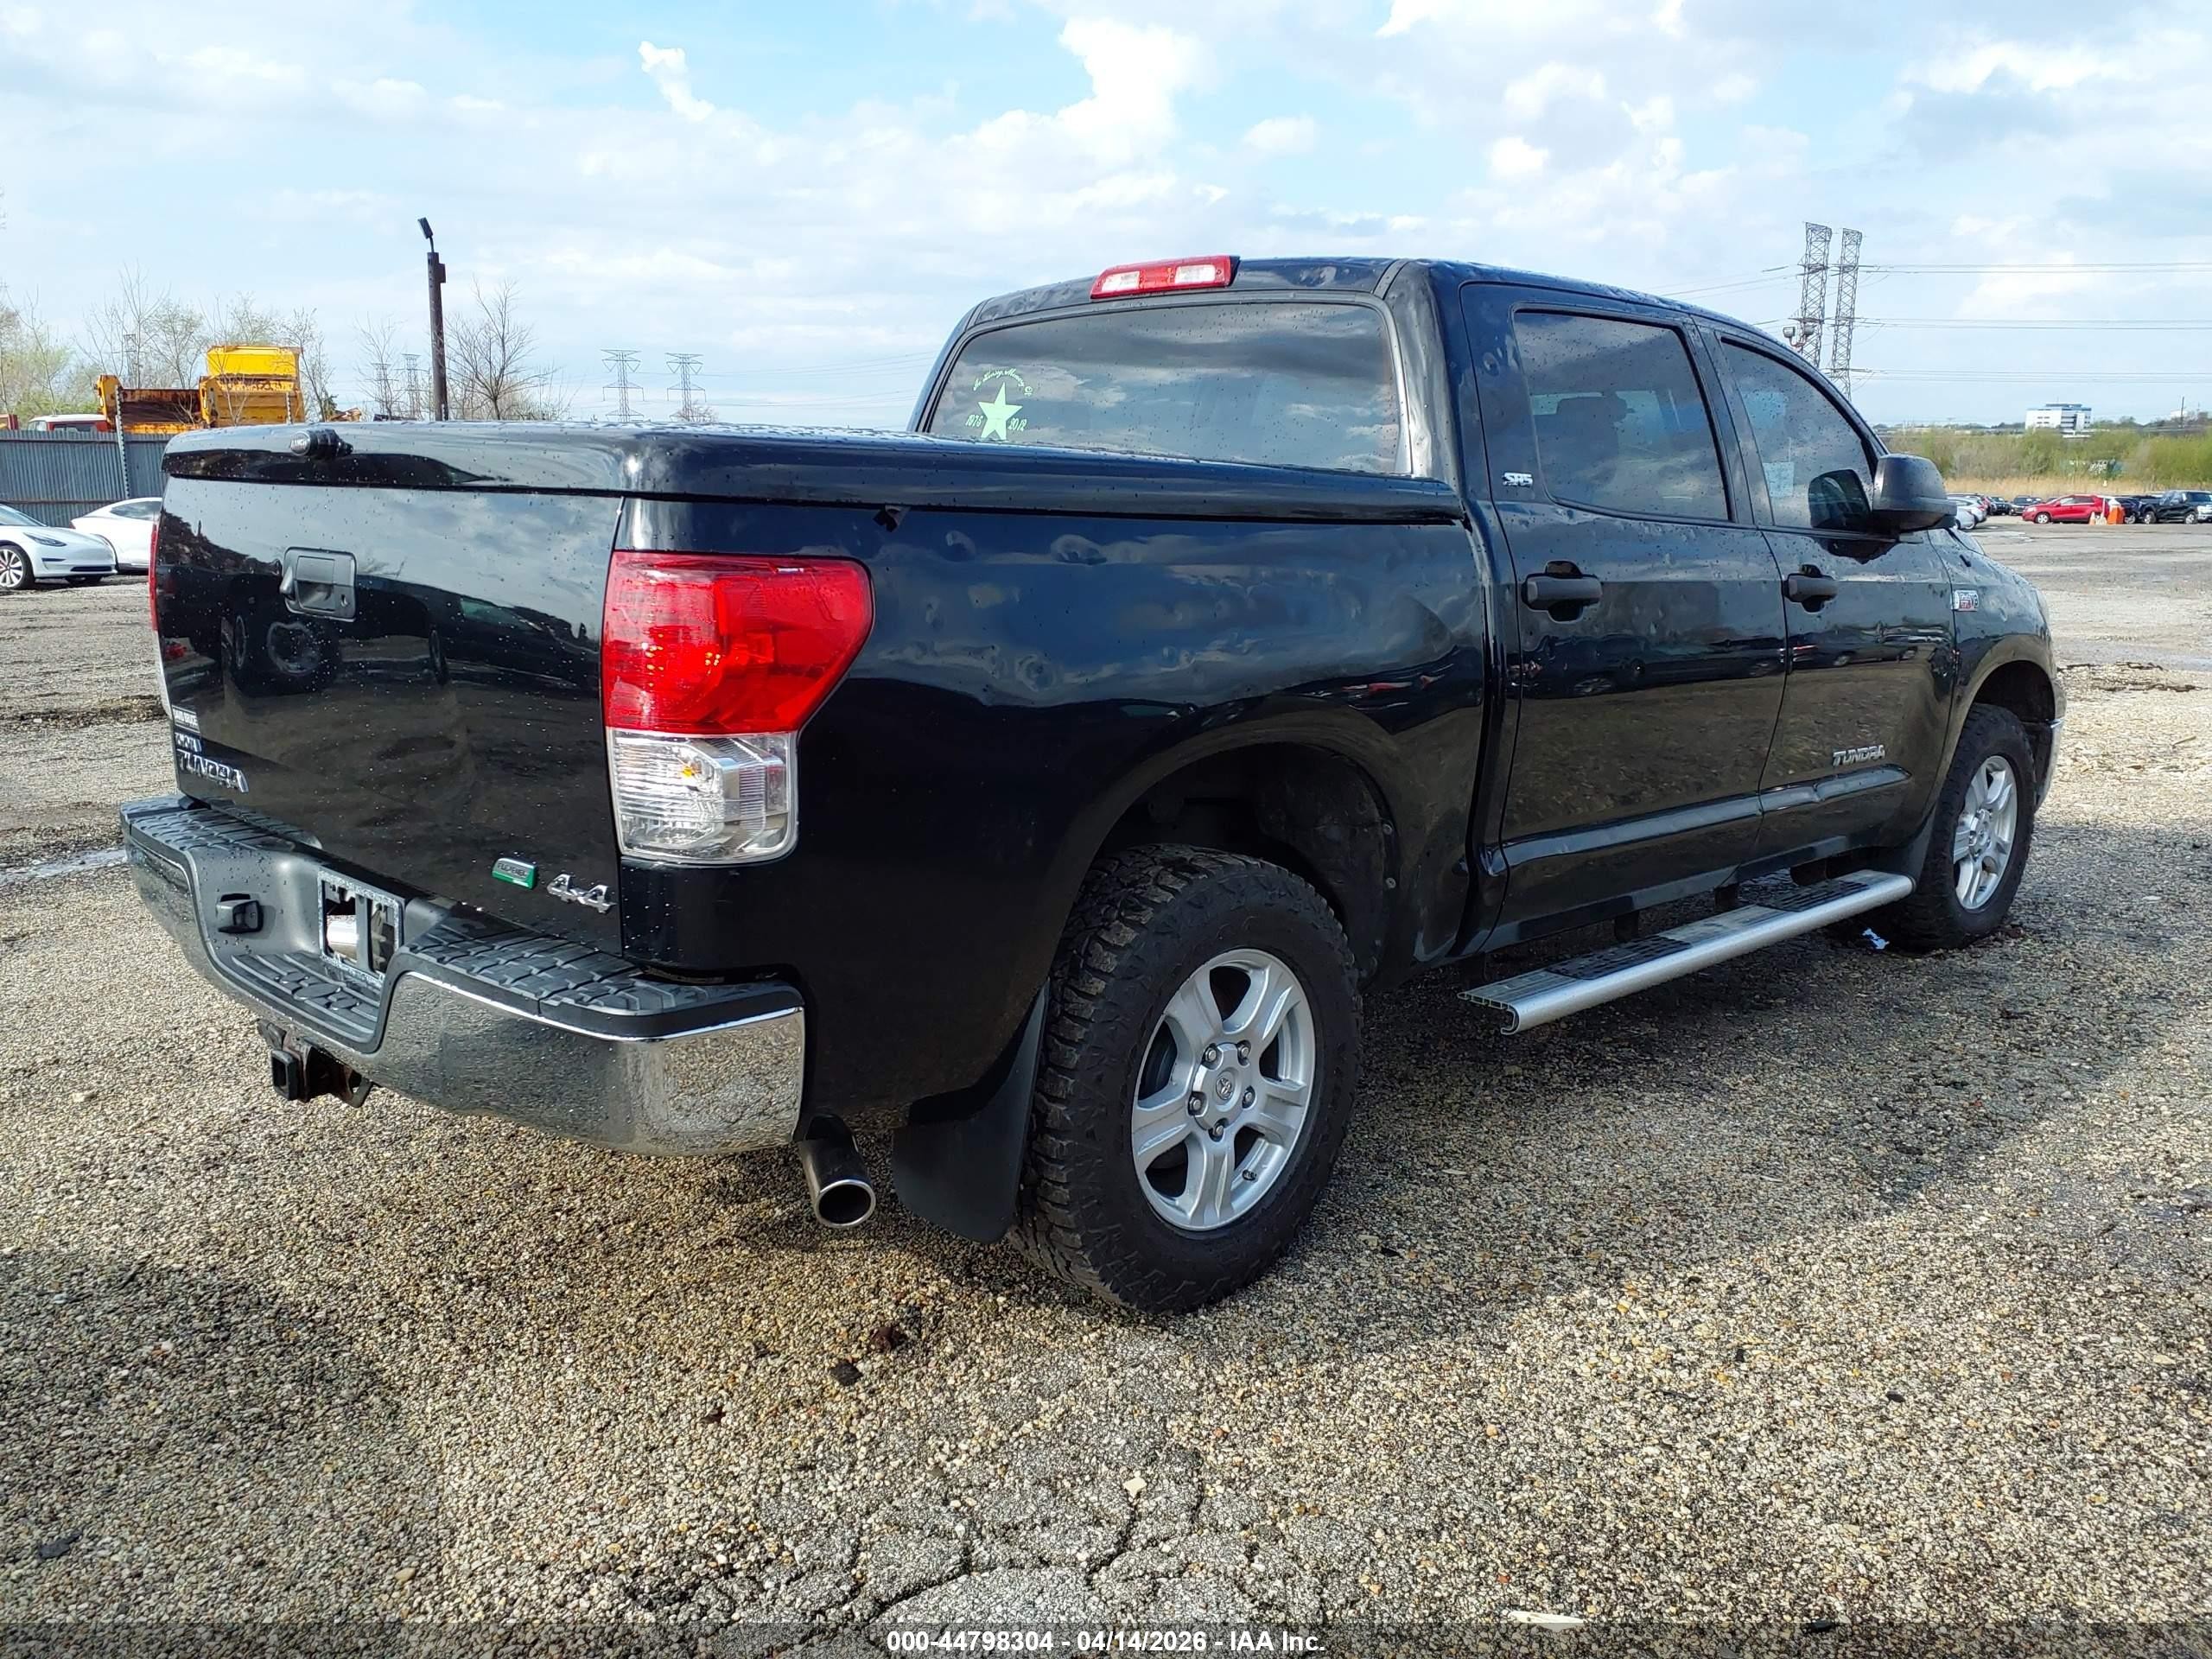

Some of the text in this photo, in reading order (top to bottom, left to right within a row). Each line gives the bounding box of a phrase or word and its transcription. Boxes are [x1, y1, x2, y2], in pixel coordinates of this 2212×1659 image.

[1503, 472, 1534, 486] SR5
[1832, 744, 1885, 767] TUNDRA
[176, 748, 249, 793] TUNDRA
